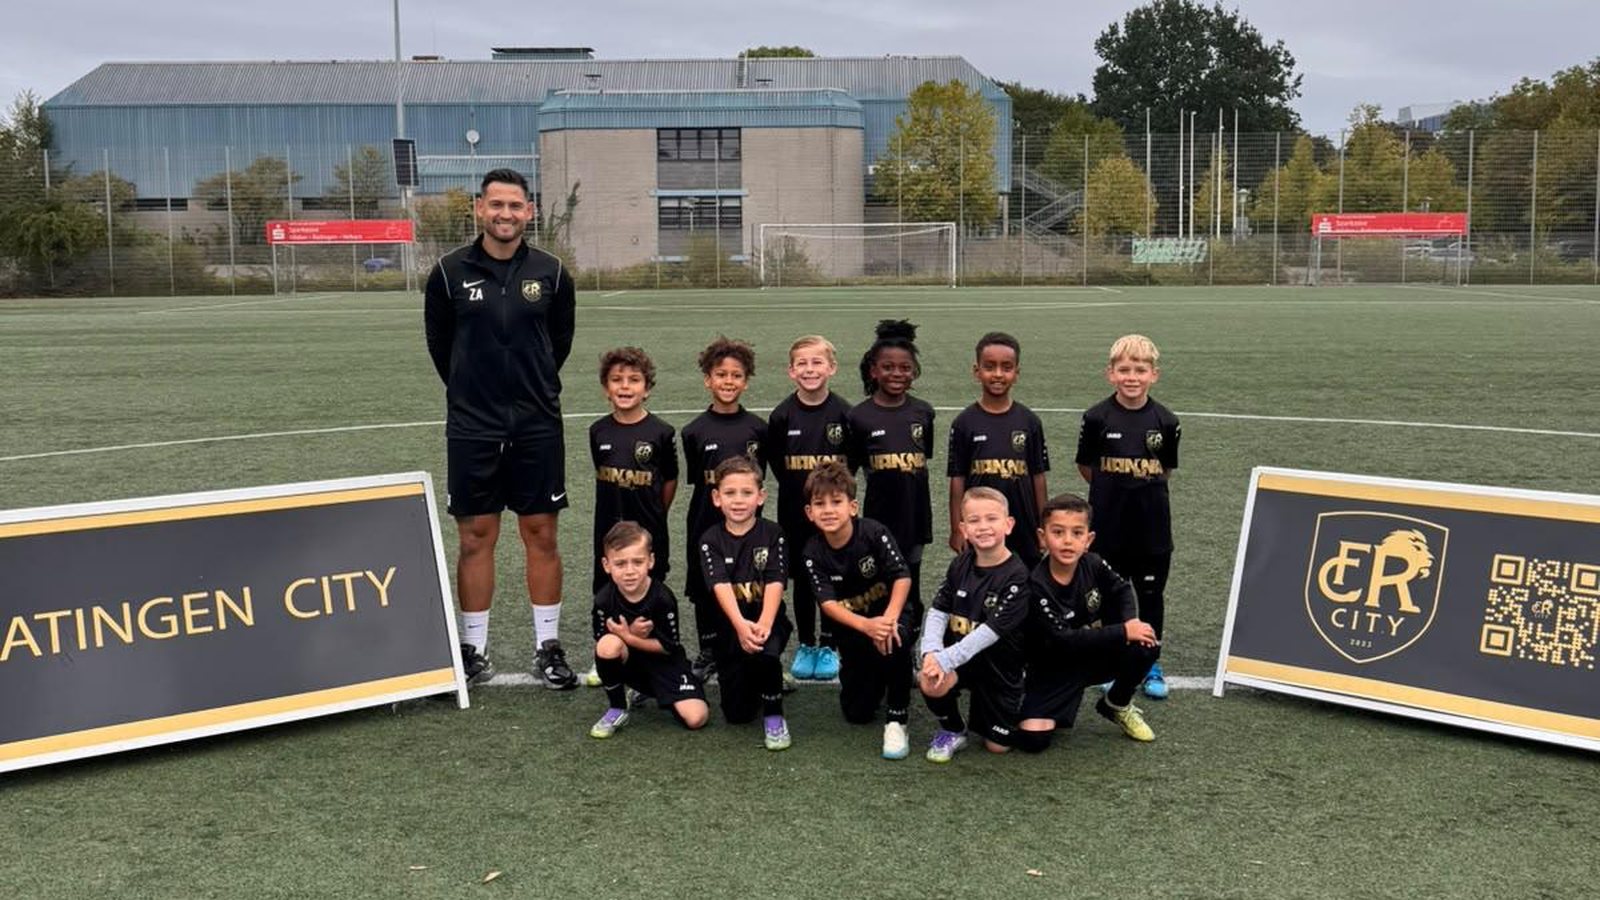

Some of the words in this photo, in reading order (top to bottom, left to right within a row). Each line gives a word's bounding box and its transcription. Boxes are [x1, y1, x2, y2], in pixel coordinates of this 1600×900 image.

[469, 288, 483, 300] ZA
[0, 586, 255, 661] ATINGEN
[284, 567, 397, 618] CITY
[1331, 608, 1405, 636] CITY
